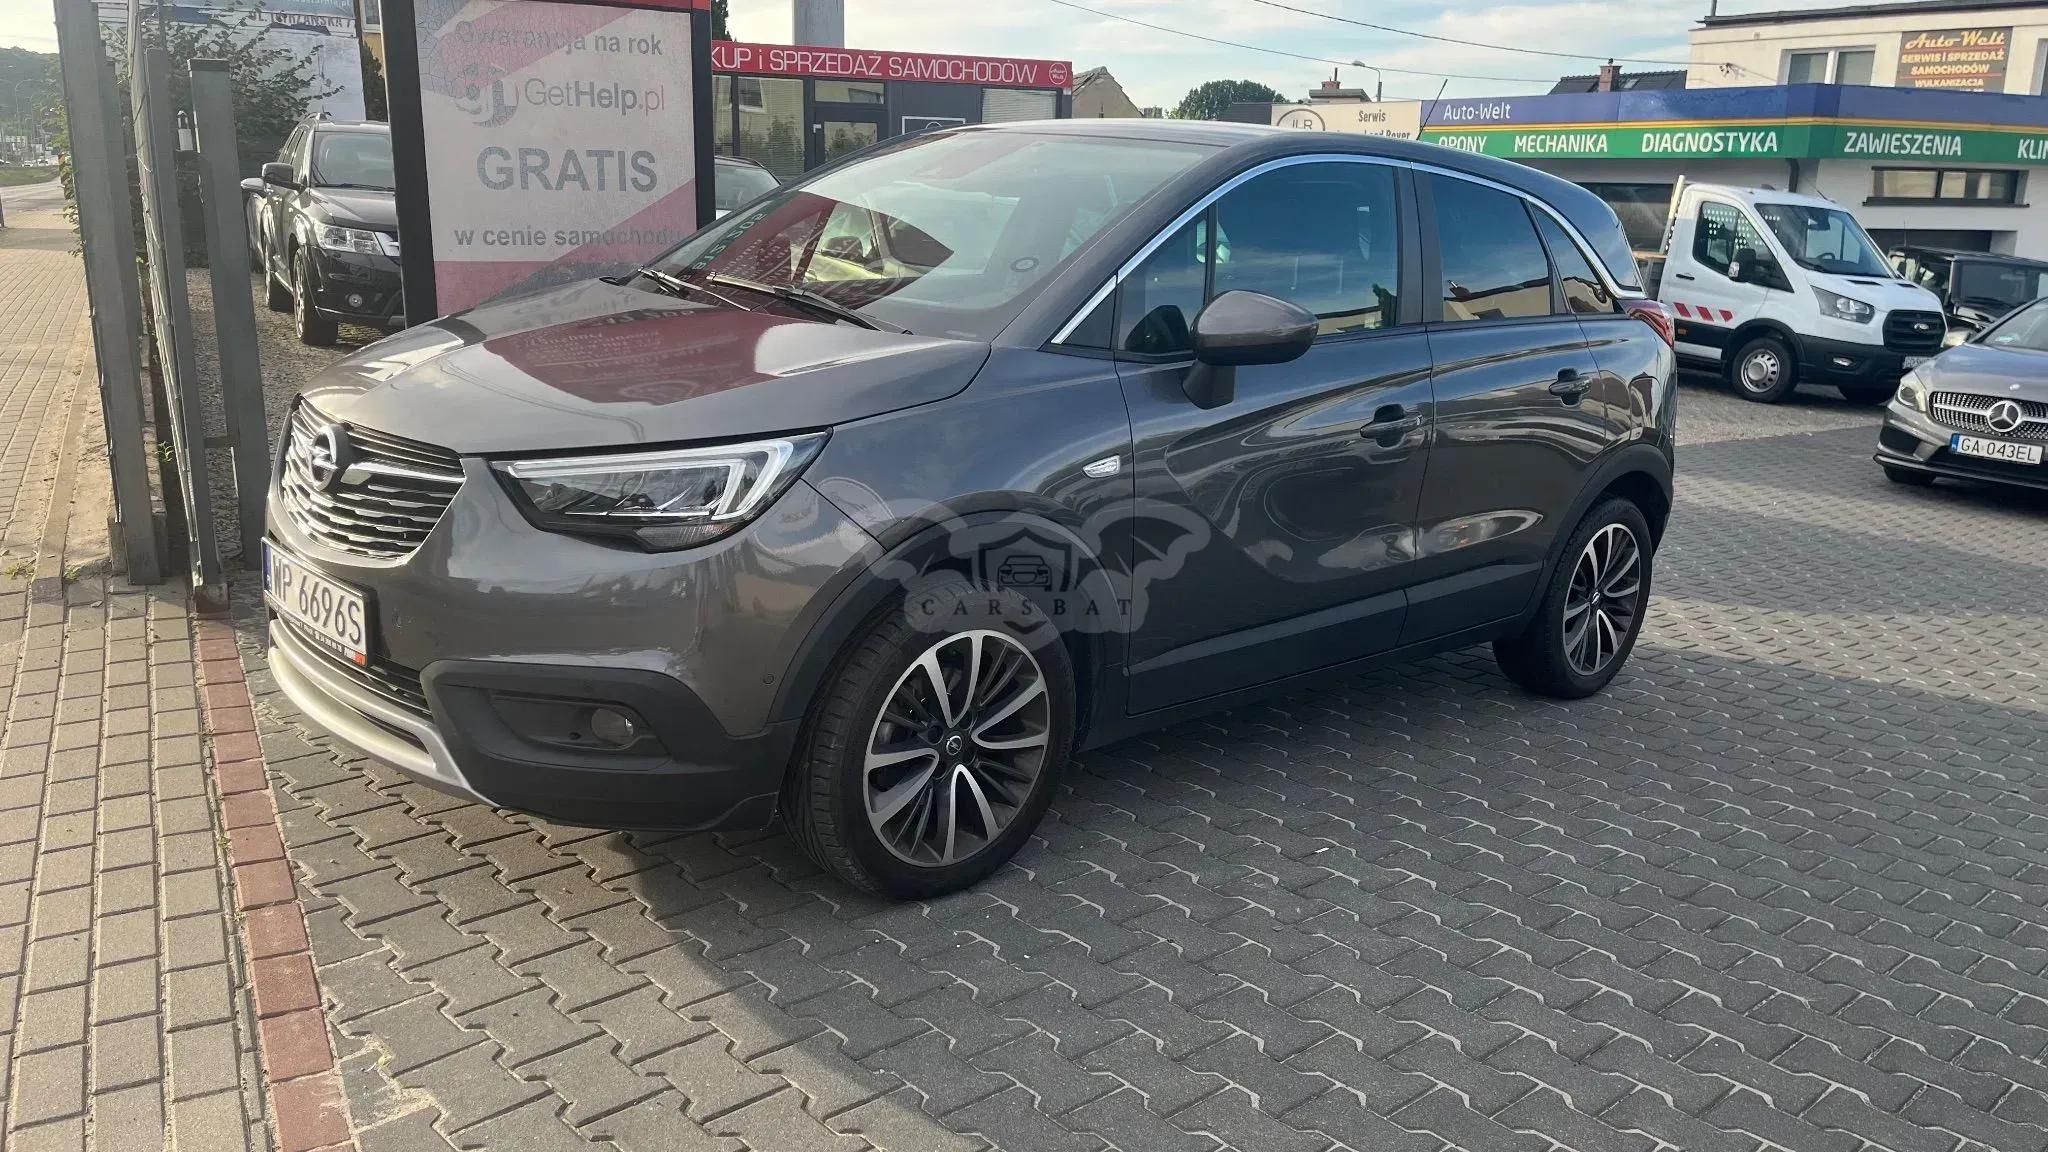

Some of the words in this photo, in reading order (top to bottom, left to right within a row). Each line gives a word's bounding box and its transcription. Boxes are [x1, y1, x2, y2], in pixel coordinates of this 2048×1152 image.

[594, 34, 621, 53] na
[628, 34, 663, 55] rok
[758, 48, 763, 70] i
[769, 50, 882, 76] SPRZEDAŻ
[889, 56, 1038, 84] SAMOCHODÓW
[1901, 52, 1942, 63] SERWIS
[1947, 48, 2005, 62] SPRZEDAŻ
[1911, 62, 1990, 75] SAMOCHODÓW
[1915, 78, 1984, 88] WULKANIZACJA
[524, 77, 665, 116] GetHelp.pl
[1358, 109, 1386, 123] Serwis
[1443, 102, 1511, 120] Auto-Welt
[1514, 134, 1608, 153] MECHANIKA
[1641, 131, 1778, 153] DIAGNOSTYKA
[1844, 132, 1962, 156] ZAWIESZENIA
[476, 146, 658, 193] GRATIS
[454, 229, 474, 246] w
[482, 226, 547, 246] cenie
[1961, 438, 1980, 453] GA
[1986, 442, 2036, 462] 043EL
[273, 554, 292, 602] WP
[300, 574, 361, 645] 6696S
